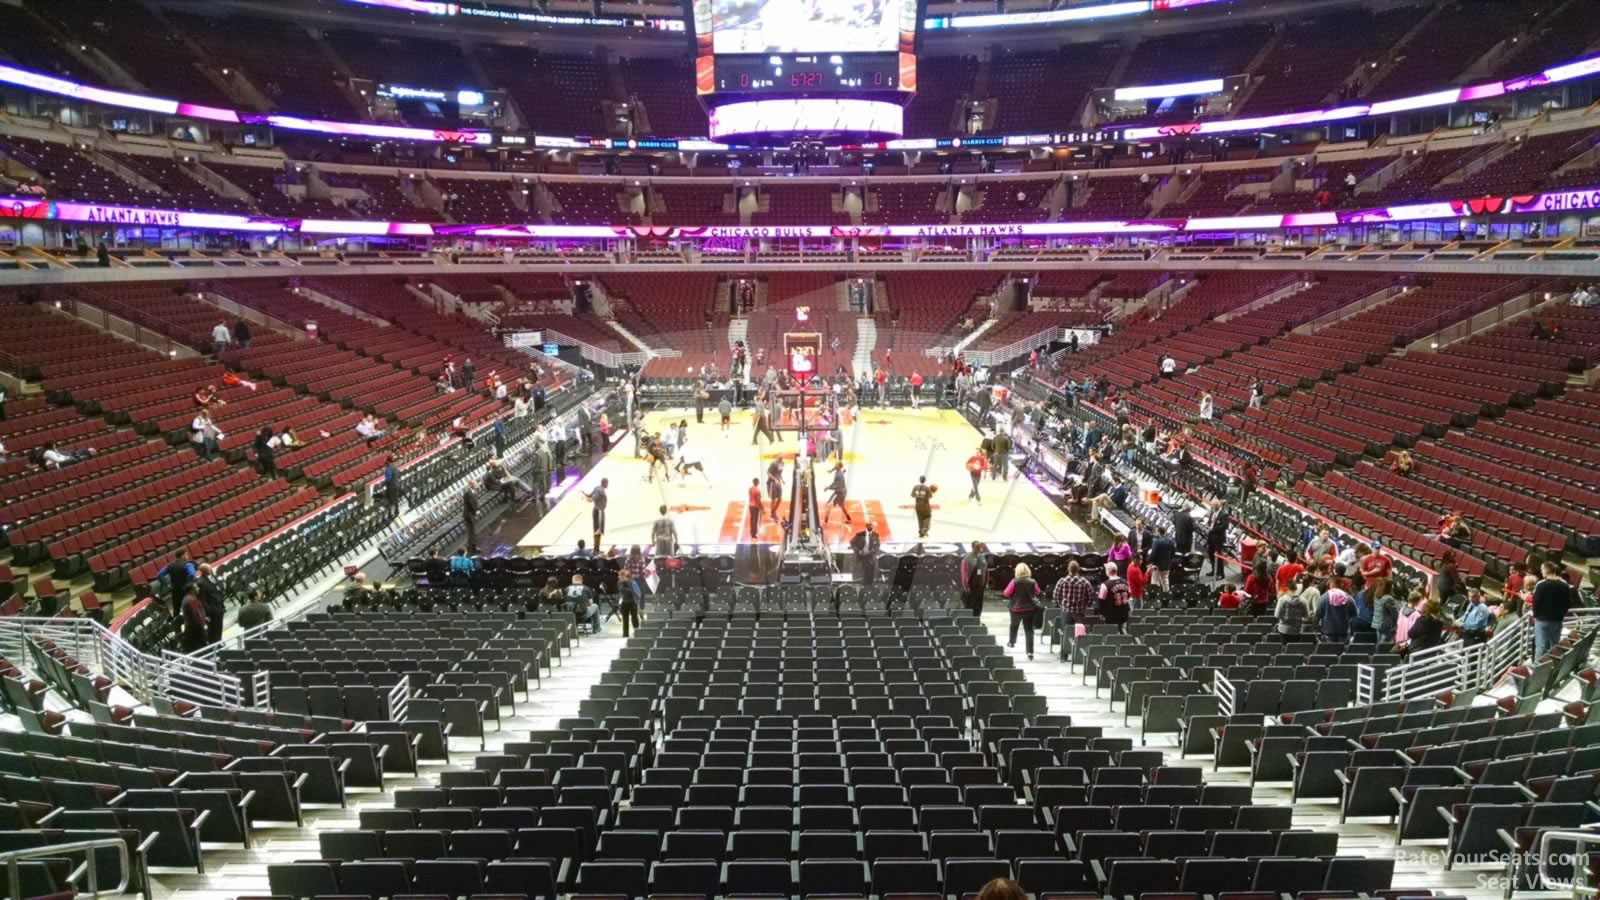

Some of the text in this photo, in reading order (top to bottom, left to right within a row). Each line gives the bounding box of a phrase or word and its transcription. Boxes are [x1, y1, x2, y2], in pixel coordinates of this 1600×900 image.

[473, 9, 499, 17] CHICAGO
[88, 207, 180, 226] ATLANTA HAWKS
[711, 227, 812, 236] CHICAGO BULLS
[918, 225, 1023, 236] ATLANTA HAWKS
